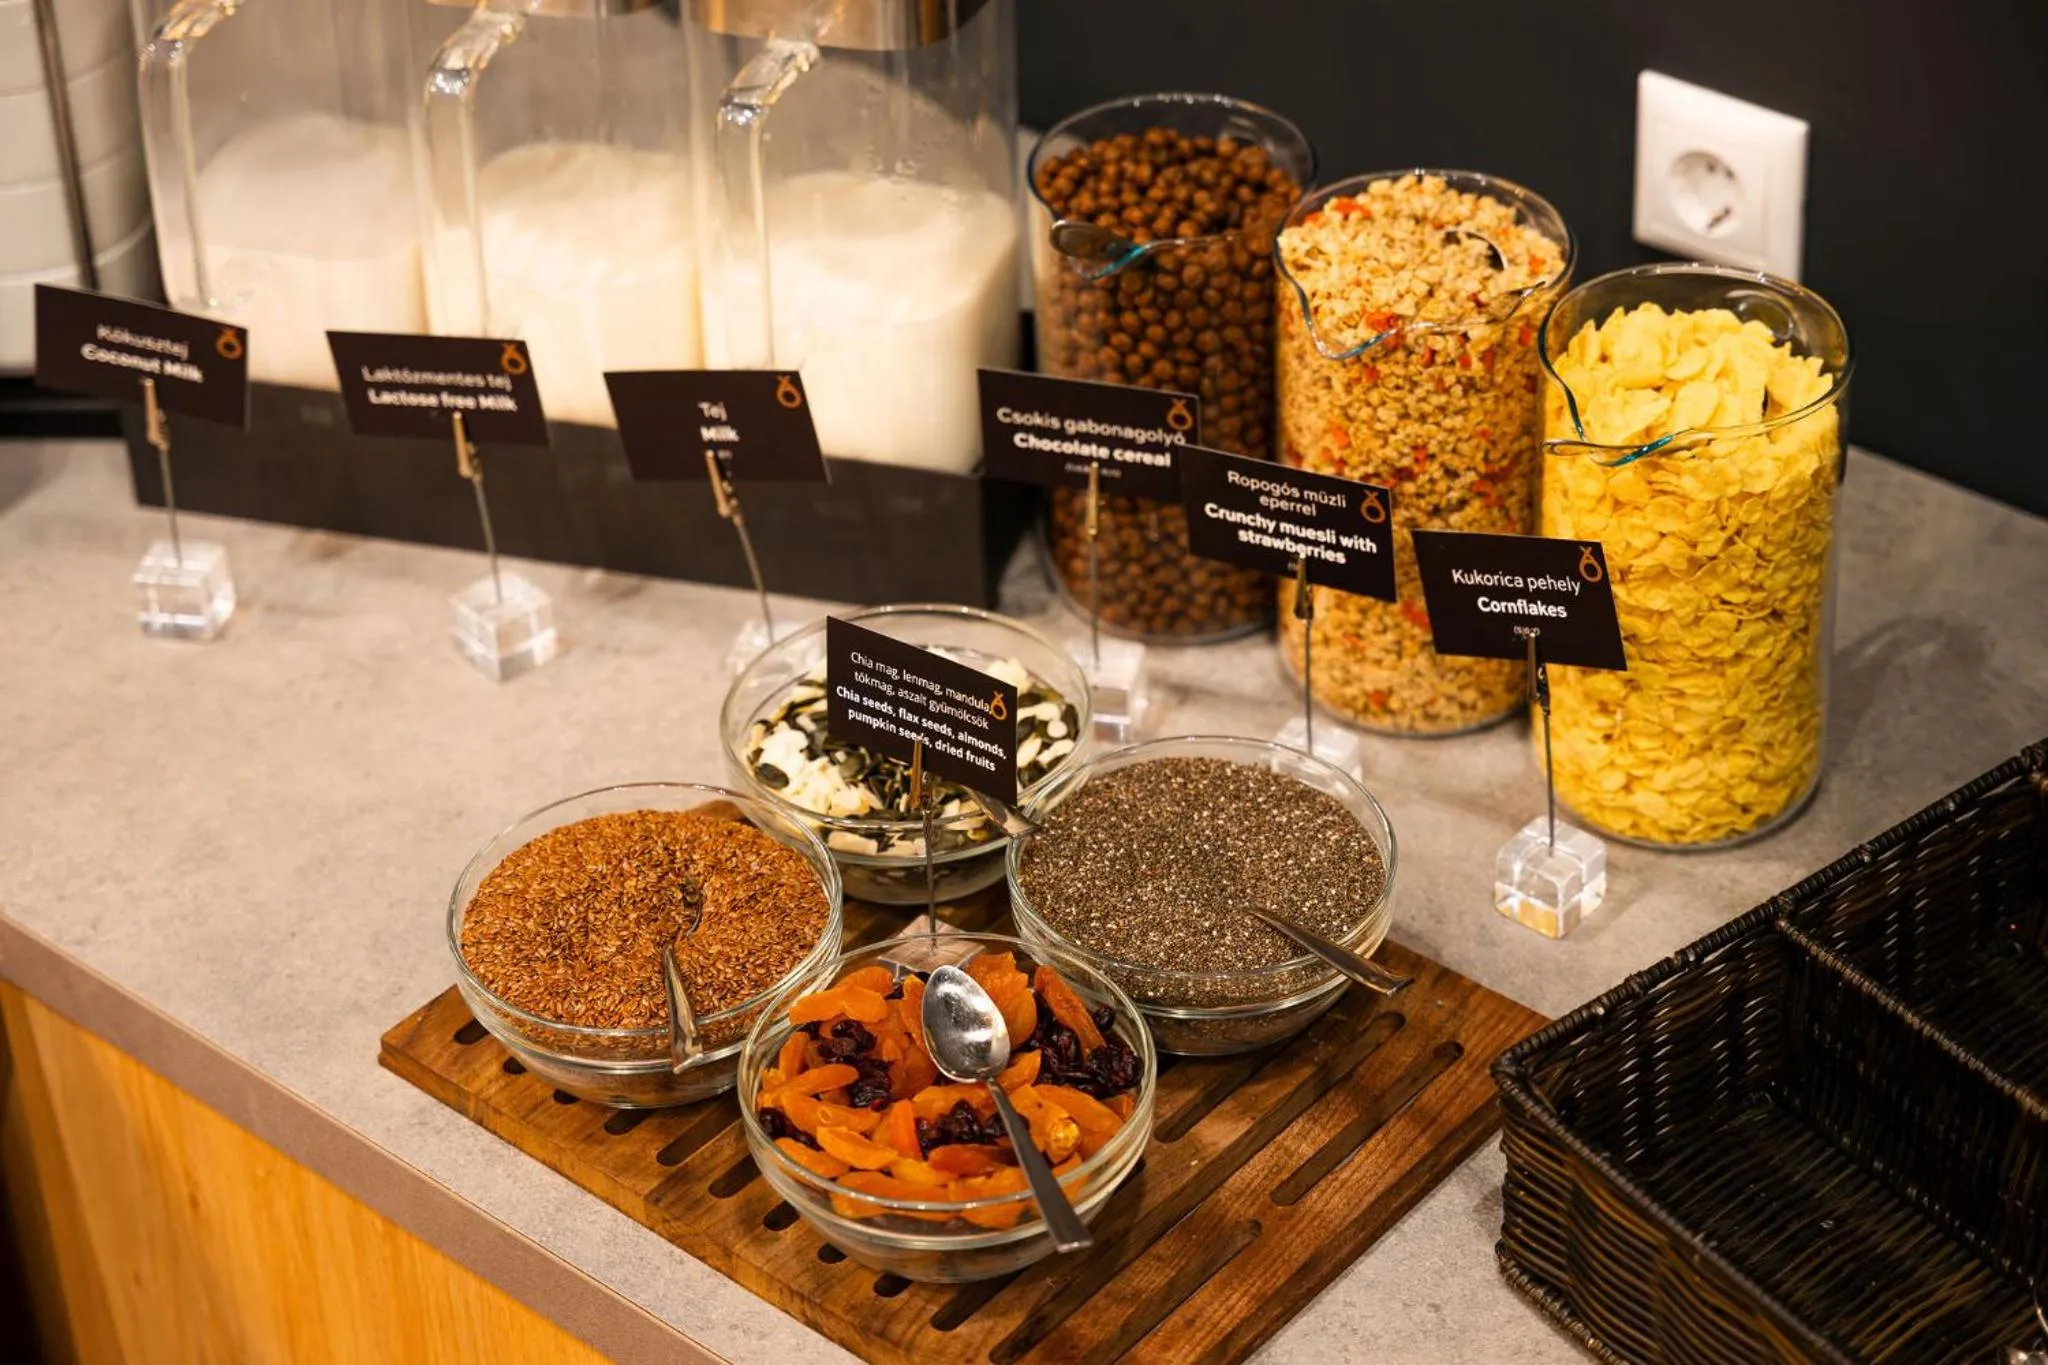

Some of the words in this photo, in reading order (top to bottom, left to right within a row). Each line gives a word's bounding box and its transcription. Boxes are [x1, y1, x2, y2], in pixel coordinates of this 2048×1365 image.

[80, 342, 161, 374] Coconut
[163, 359, 204, 384] Milk
[367, 387, 439, 407] Lactose
[440, 391, 477, 409] free
[478, 393, 518, 412] Milk
[486, 374, 512, 392] tej
[698, 401, 728, 422] Tej
[996, 406, 1061, 430] Csokis
[1063, 417, 1186, 447] gabonagolyó
[700, 425, 740, 442] Milk
[1013, 431, 1110, 460] Chocolate
[1112, 446, 1172, 468] cereal
[1227, 470, 1300, 498] Ropogós
[1303, 488, 1347, 508] müzli
[1259, 494, 1316, 517] eperrel
[1204, 502, 1276, 533] Crunchy
[1279, 521, 1337, 545] muesli
[1339, 534, 1377, 554] with
[1237, 528, 1347, 565] strawberries
[1451, 568, 1524, 588] Kukorica
[1527, 574, 1581, 596] pehely
[1477, 596, 1568, 618] Cornflakes
[850, 651, 873, 668] Chia
[875, 661, 900, 681] mag,
[902, 669, 943, 695] lenmag,
[854, 671, 895, 696] tökmag,
[897, 688, 927, 706] aszalt
[929, 699, 989, 730] gyümölcsök
[836, 685, 860, 703] Chia
[862, 696, 896, 717] seeds,
[898, 707, 919, 725] flax
[921, 716, 956, 739] seeds,
[957, 731, 1008, 760] almonds,
[848, 708, 897, 734] pumpkin
[934, 737, 968, 758] dried
[965, 750, 996, 772] fruits
